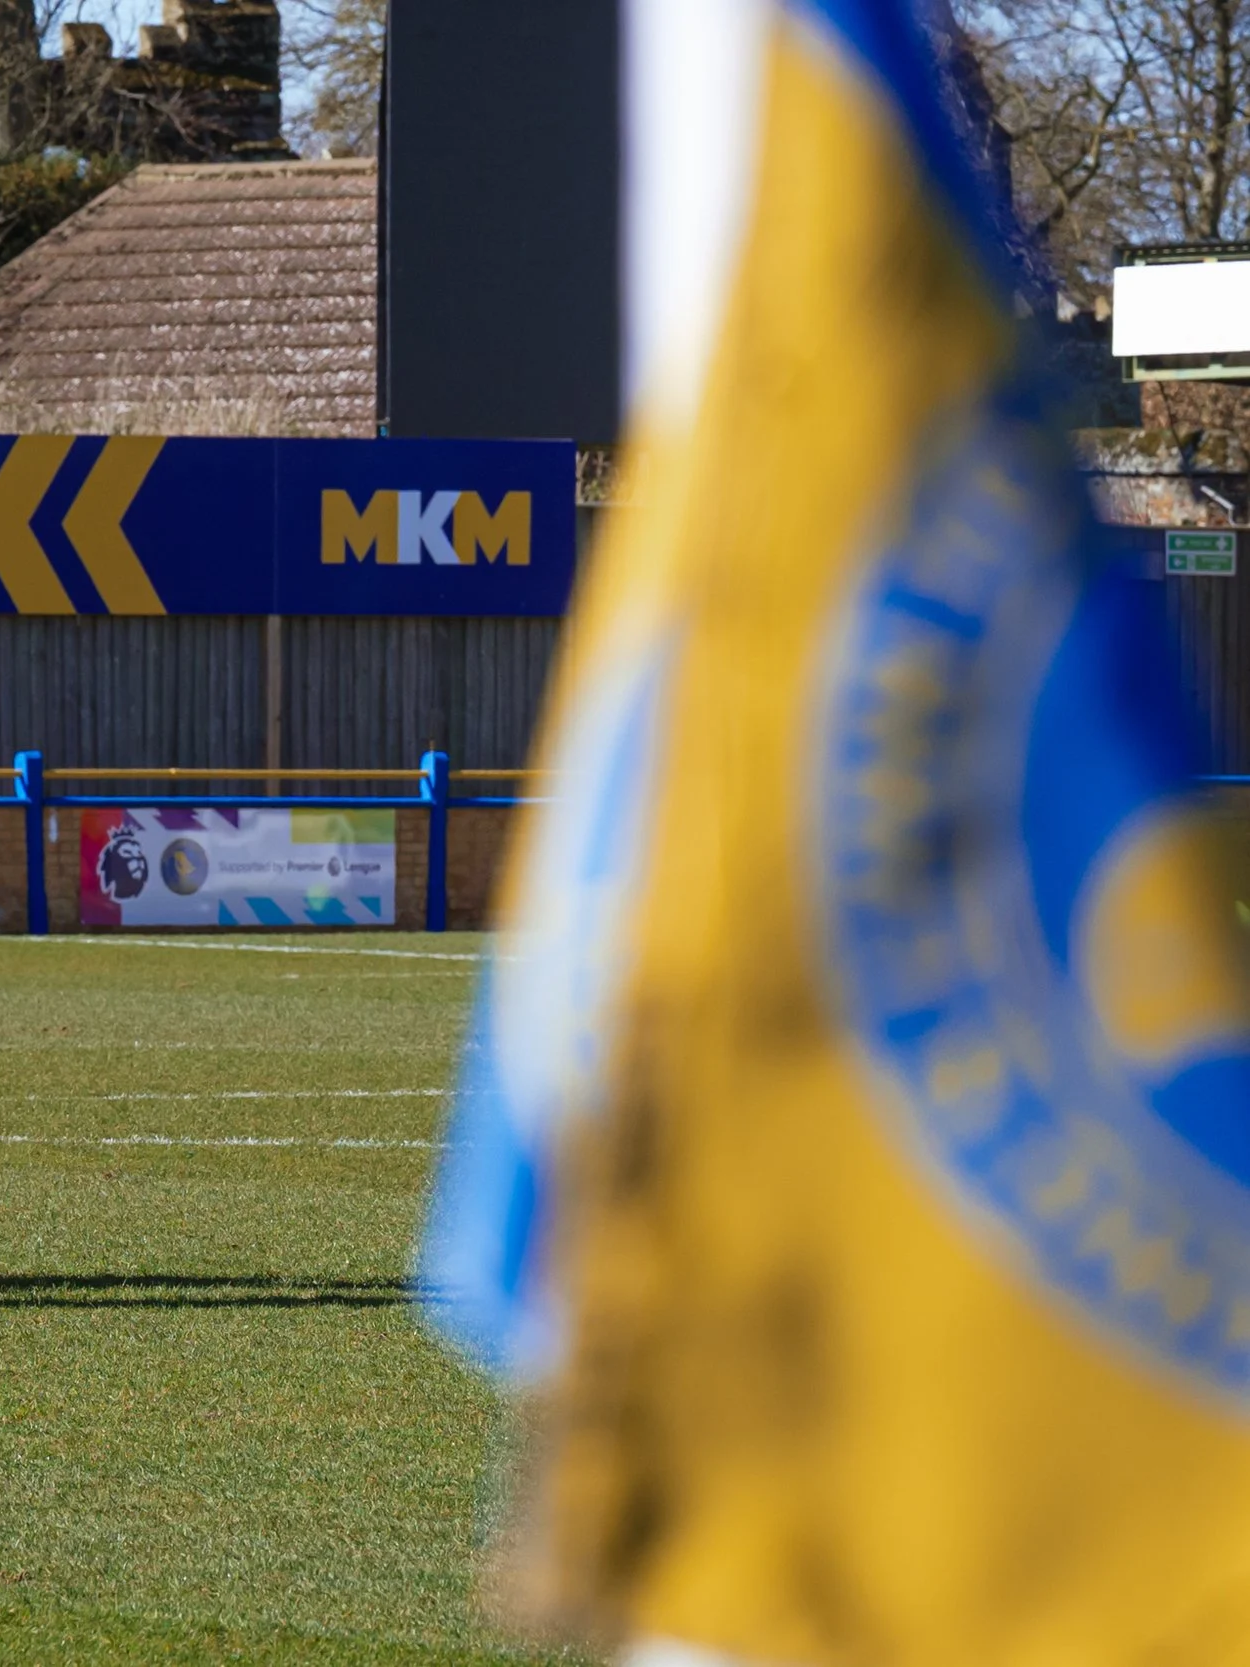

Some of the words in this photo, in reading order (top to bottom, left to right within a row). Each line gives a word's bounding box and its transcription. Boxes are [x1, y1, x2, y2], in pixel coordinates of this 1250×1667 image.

[321, 489, 532, 565] MKM
[218, 861, 270, 873] Supported
[287, 860, 324, 871] Premier
[343, 861, 381, 875] League
